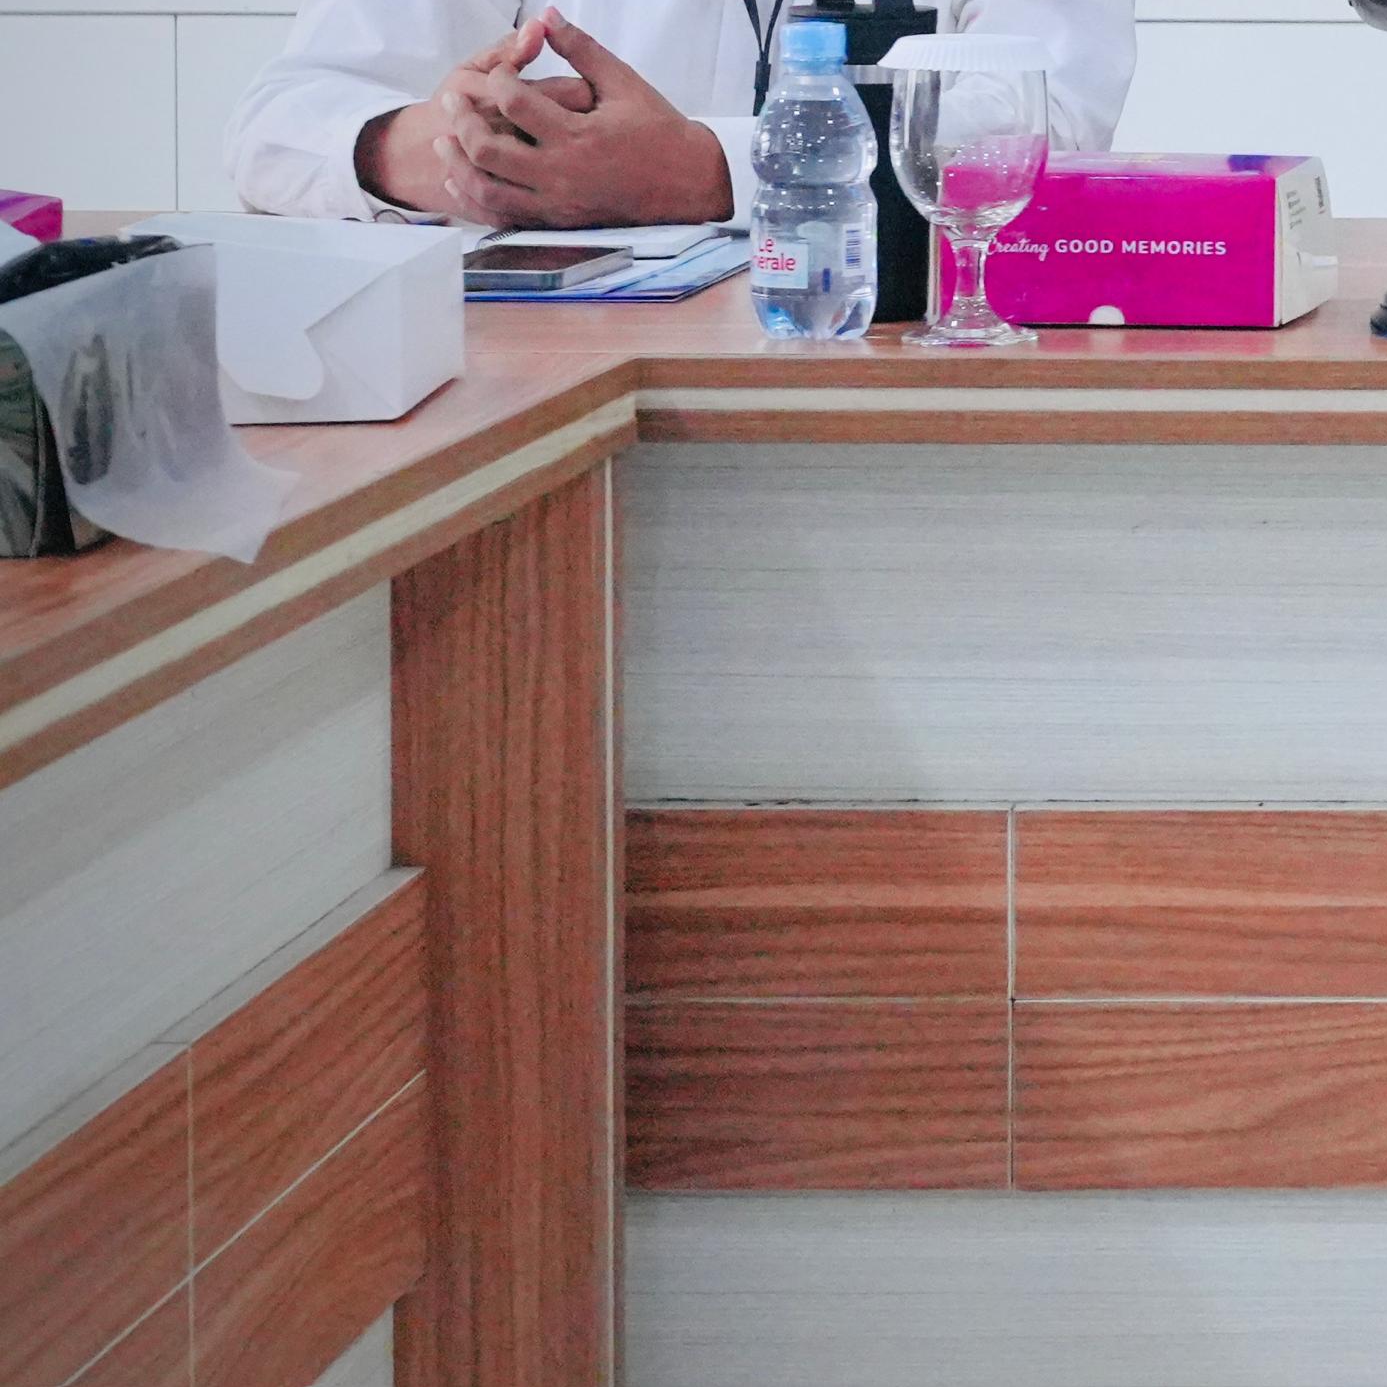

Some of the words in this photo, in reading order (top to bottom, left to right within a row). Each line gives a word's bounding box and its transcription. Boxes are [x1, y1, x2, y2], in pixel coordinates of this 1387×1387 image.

[987, 237, 1051, 262] Creating
[1054, 239, 1114, 254] GOOD
[1121, 239, 1227, 255] MEMORIES
